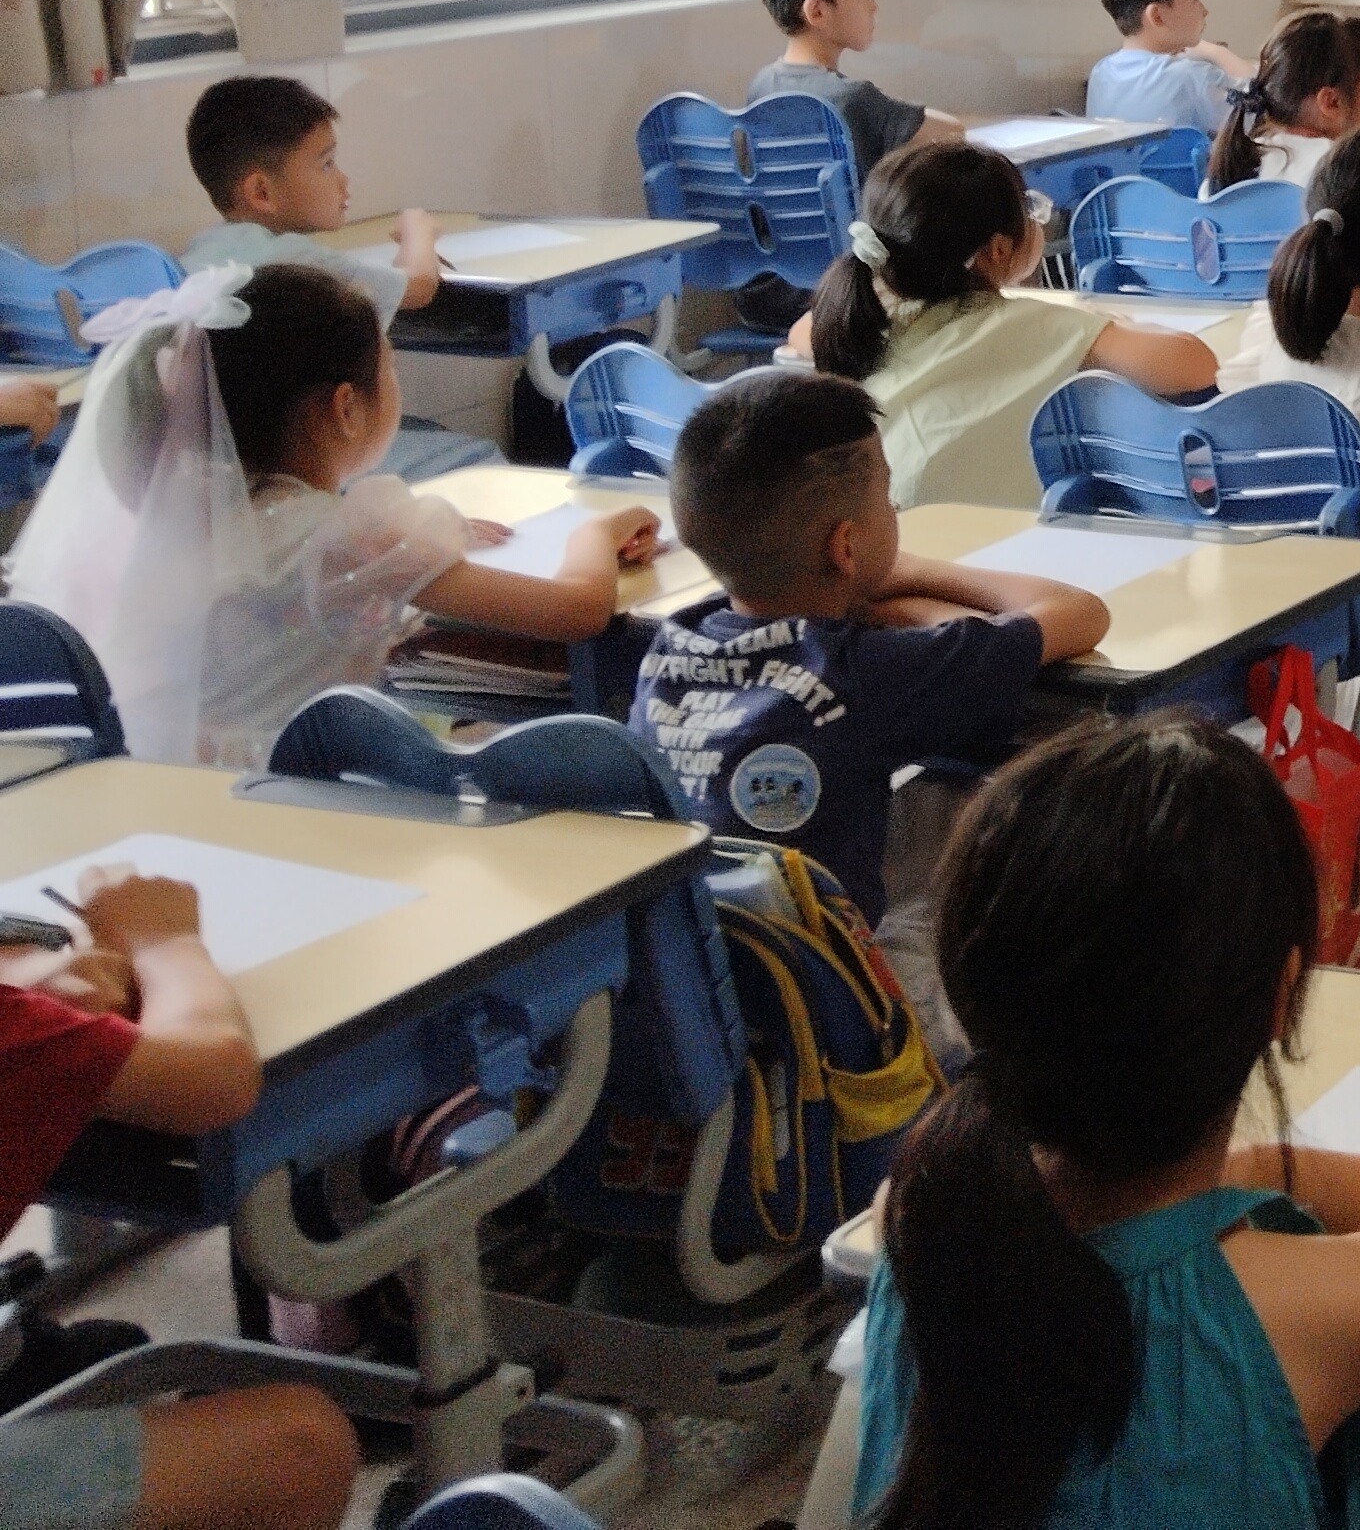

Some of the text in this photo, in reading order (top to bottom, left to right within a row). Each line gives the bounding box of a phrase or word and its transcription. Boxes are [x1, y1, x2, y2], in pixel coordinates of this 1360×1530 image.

[724, 619, 808, 656] TEAM!
[666, 656, 752, 689] FIGHT,
[758, 660, 847, 727] FIGHT!
[679, 691, 737, 712] PLAY
[656, 725, 711, 749] WITH
[668, 749, 724, 776] YOUR
